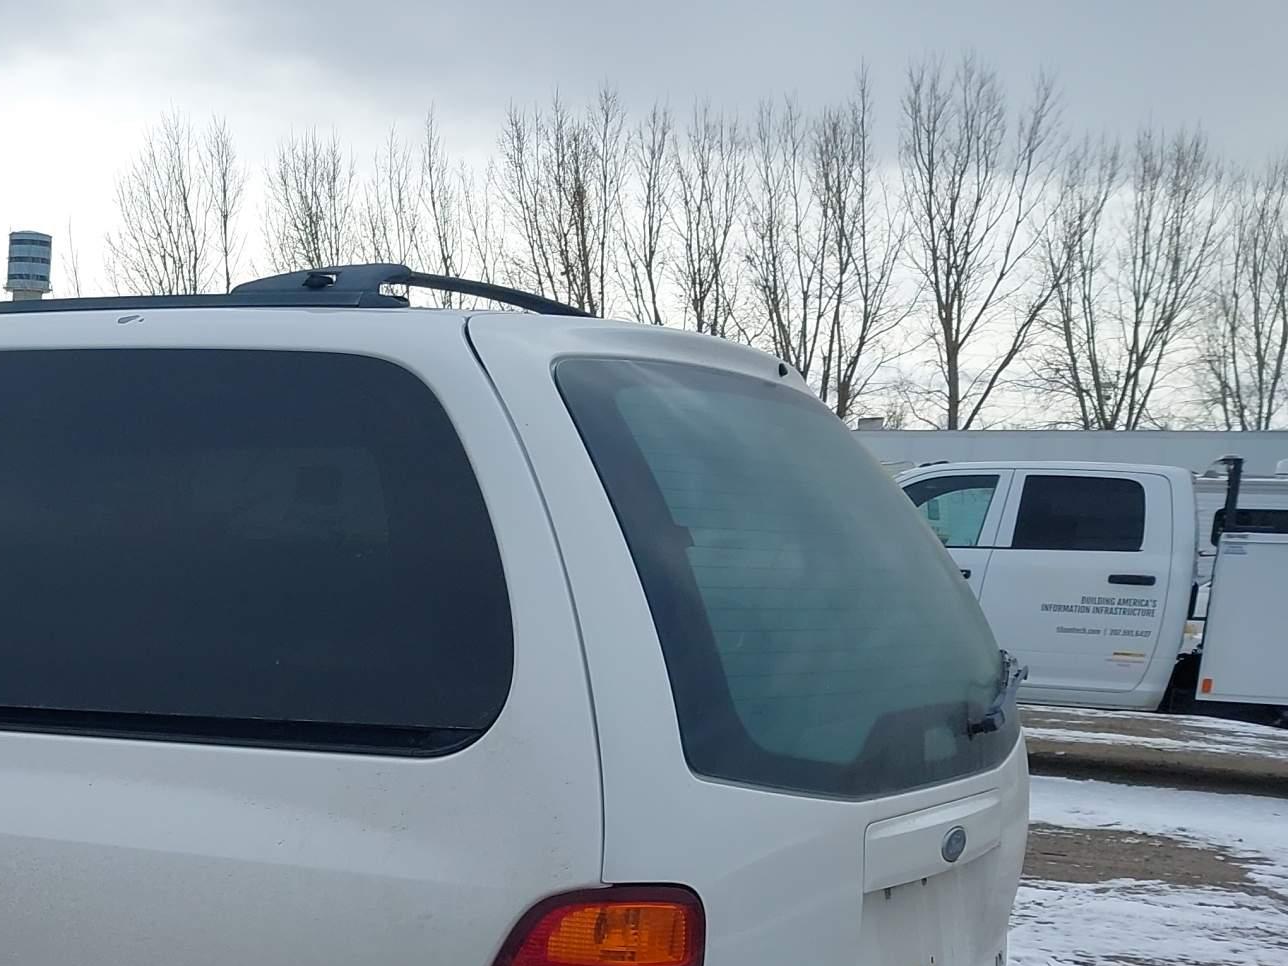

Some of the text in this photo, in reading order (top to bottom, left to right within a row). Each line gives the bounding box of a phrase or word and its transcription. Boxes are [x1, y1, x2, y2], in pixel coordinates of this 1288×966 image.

[1081, 596, 1158, 608] BUILDING AMERICA'S
[1041, 603, 1156, 618] INFORMATION INFRASTRUCTURE
